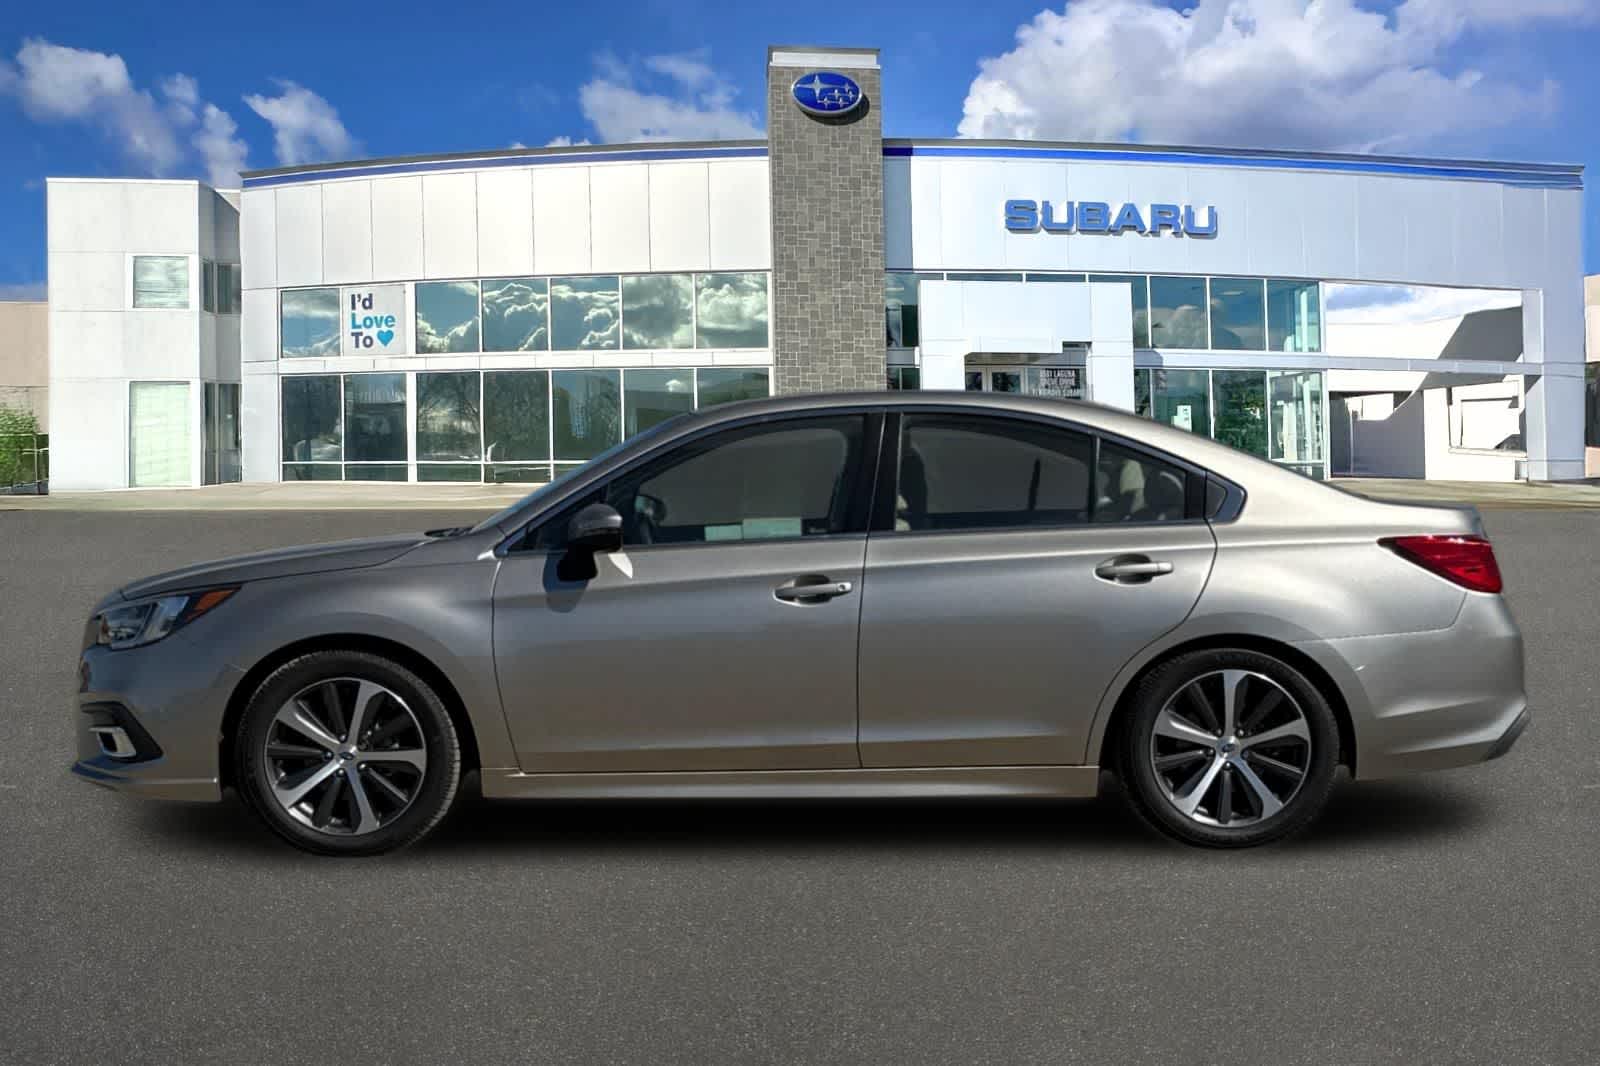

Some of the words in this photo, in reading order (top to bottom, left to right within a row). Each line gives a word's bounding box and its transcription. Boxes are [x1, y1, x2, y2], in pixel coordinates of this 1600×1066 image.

[1005, 200, 1218, 238] SUBARU
[351, 312, 396, 329] Love
[351, 332, 374, 348] To
